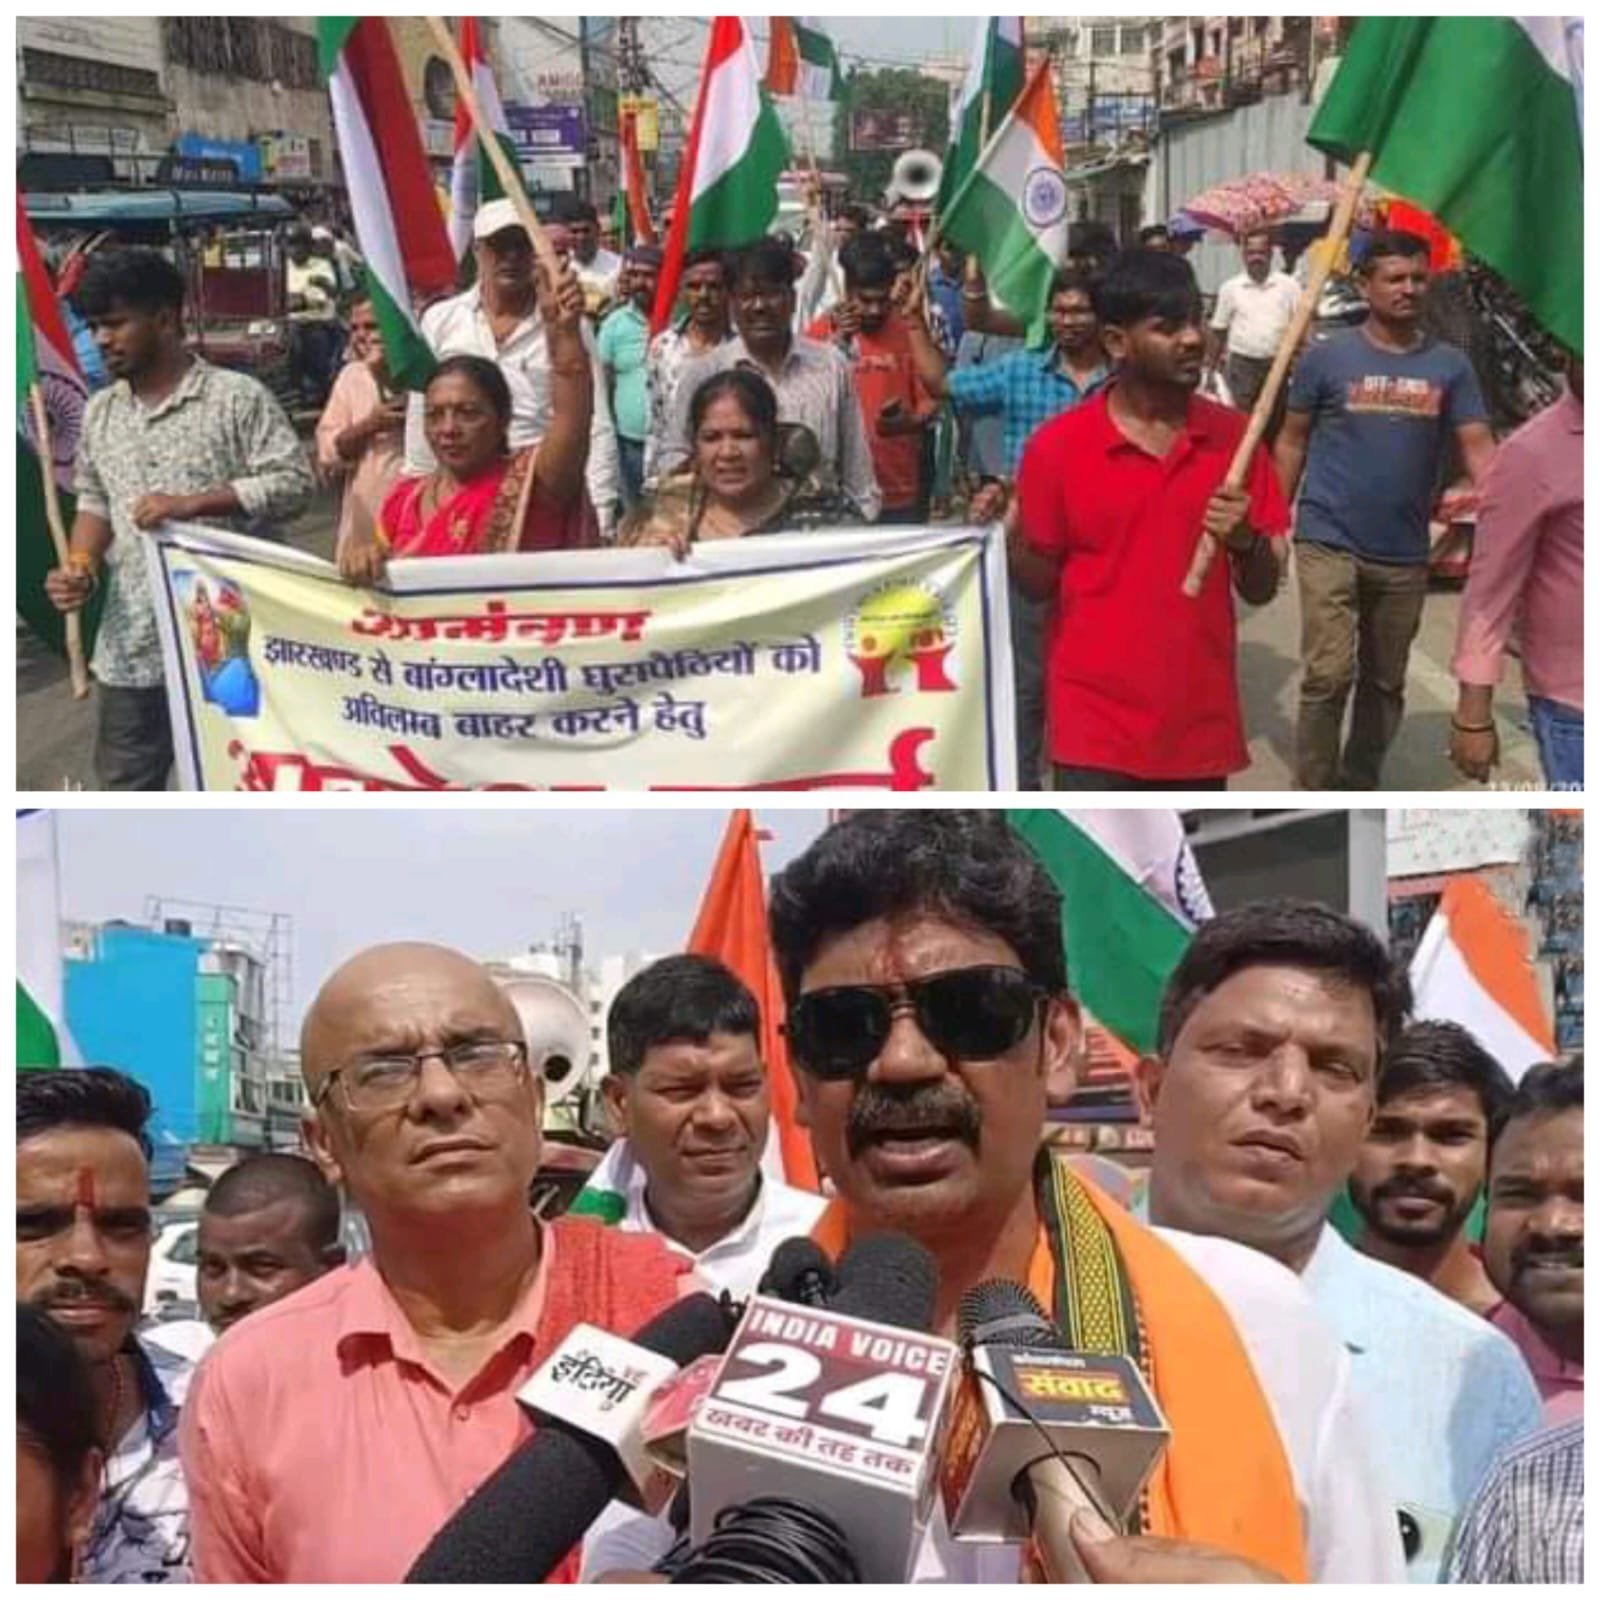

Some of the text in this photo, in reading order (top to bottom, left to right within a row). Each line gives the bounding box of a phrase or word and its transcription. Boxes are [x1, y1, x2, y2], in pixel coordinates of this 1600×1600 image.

[370, 653, 392, 686] से
[404, 653, 568, 695] बांग्लादेशी
[772, 633, 822, 674] को
[453, 713, 536, 740] बाहर
[552, 697, 640, 738] करने
[654, 691, 707, 739] हेतु
[749, 1308, 948, 1376] INDIA VOICE
[715, 1341, 928, 1447] 24
[706, 1407, 916, 1475] खबर की तह तक
